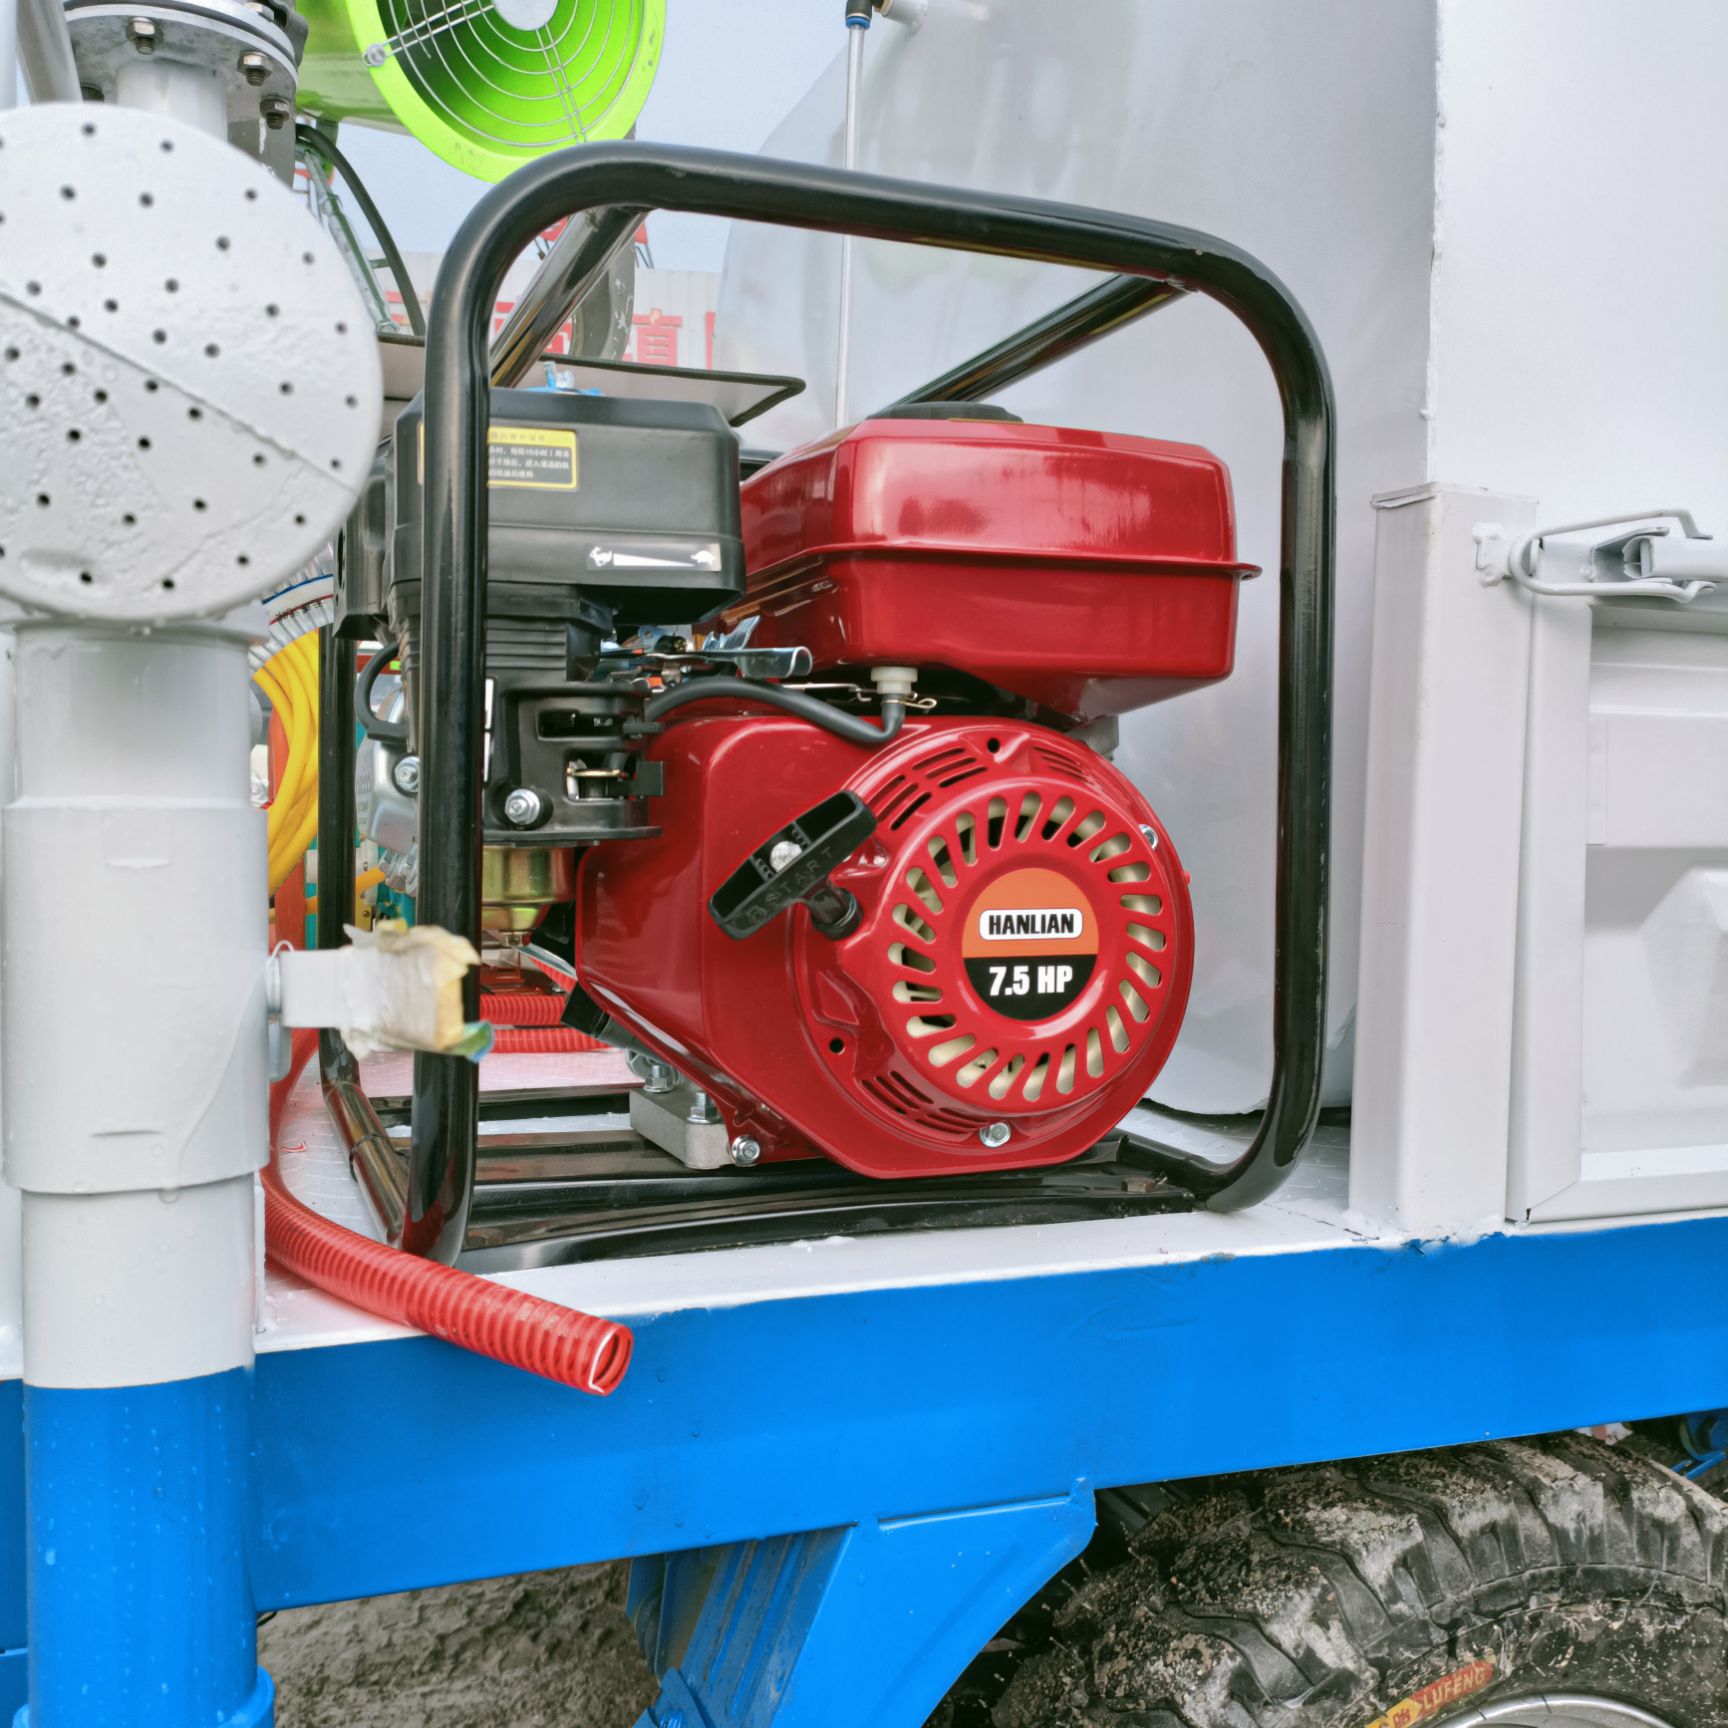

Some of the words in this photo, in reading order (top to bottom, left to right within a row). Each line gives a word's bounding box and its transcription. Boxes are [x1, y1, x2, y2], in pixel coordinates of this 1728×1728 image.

[766, 847, 832, 905] START
[988, 914, 1074, 935] HANLIAN
[989, 965, 1030, 996] 7.5
[1037, 965, 1073, 994] HP
[1422, 1666, 1486, 1709] LUFENG
